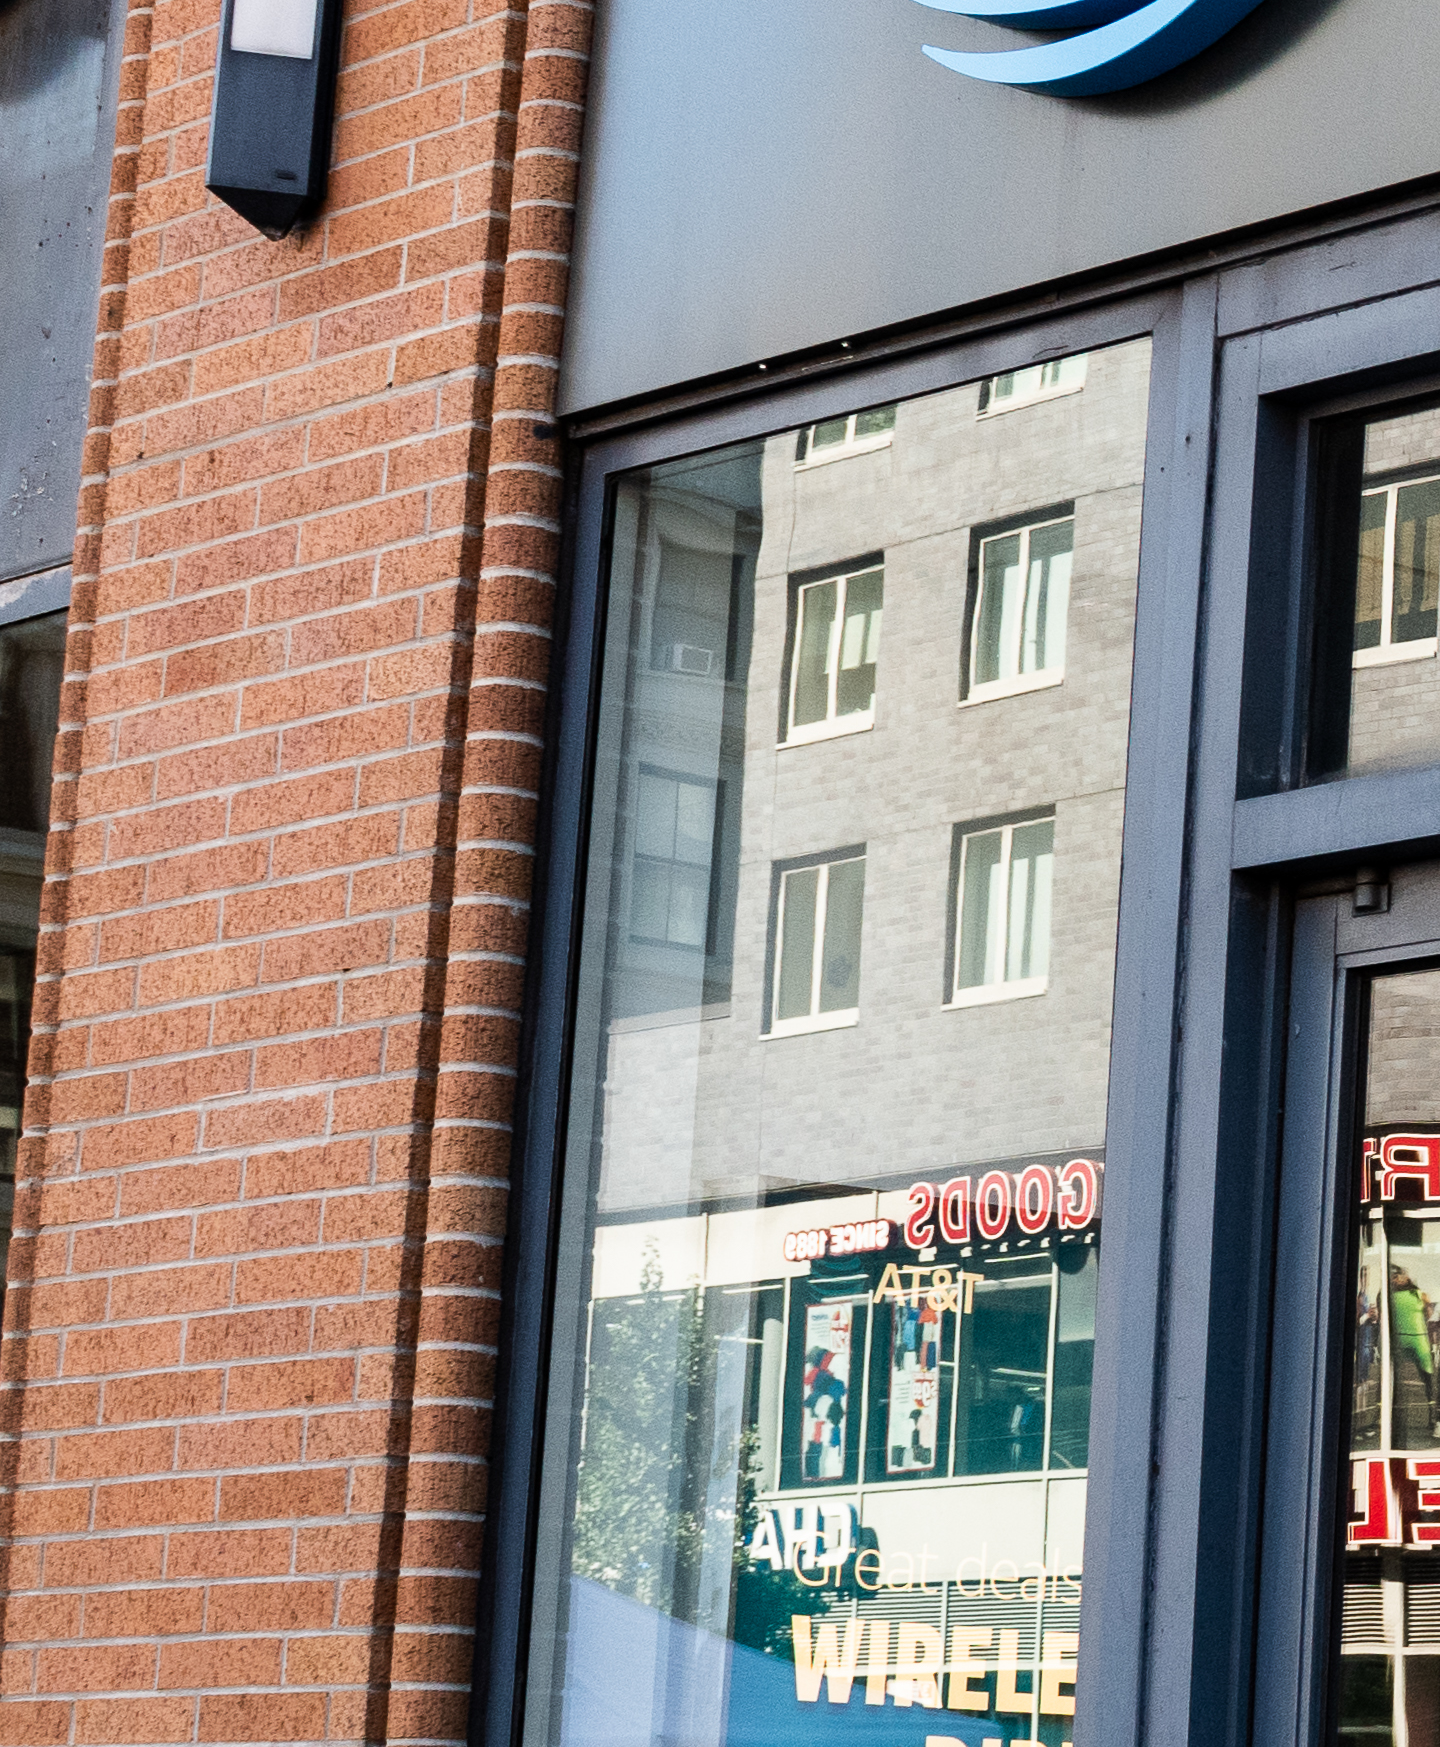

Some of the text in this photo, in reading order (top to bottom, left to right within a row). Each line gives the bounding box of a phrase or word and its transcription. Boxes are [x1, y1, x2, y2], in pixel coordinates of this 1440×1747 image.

[873, 1262, 985, 1315] AT&T
[793, 1530, 1083, 1604] Great deals
[791, 1614, 1080, 1716] WIRELE
